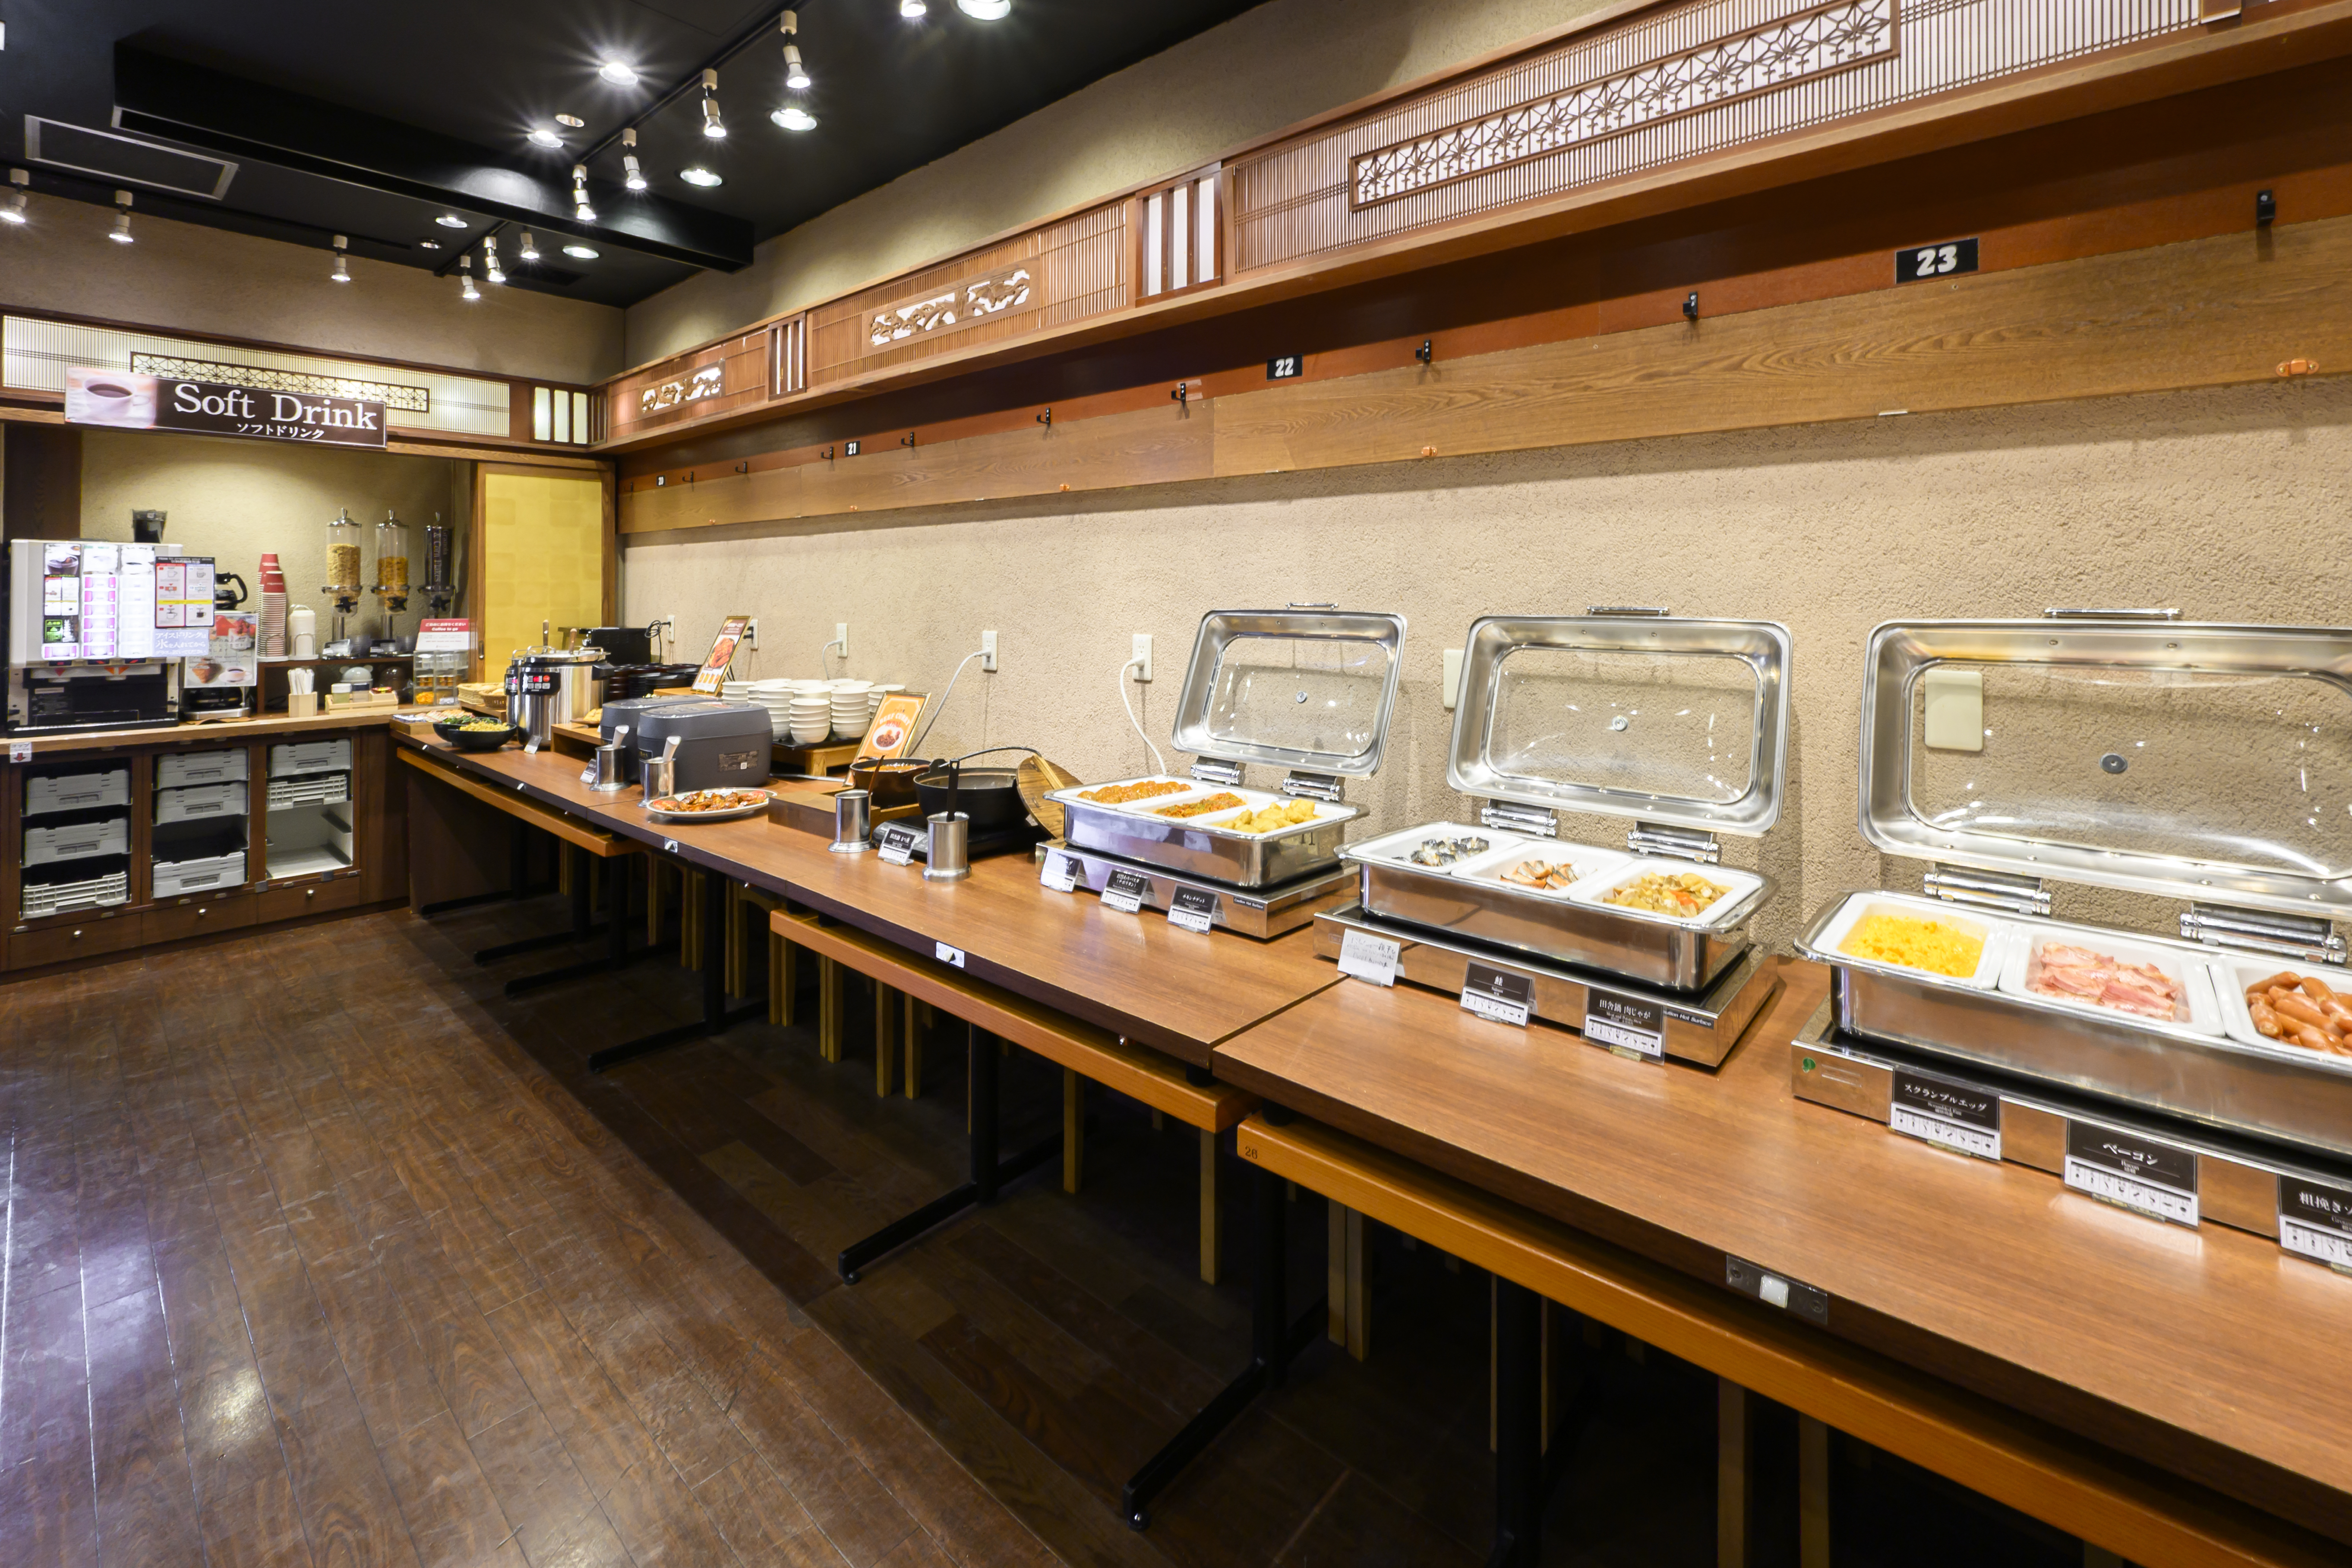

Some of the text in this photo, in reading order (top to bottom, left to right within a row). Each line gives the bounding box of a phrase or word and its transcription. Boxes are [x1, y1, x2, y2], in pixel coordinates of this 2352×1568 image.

[1916, 245, 1957, 276] 23
[1275, 357, 1294, 377] 22
[174, 383, 377, 430] Soft Drink
[237, 423, 324, 440] ソフトドリンク
[848, 442, 856, 454] 21
[879, 713, 911, 726] BEEF CURRY
[1494, 975, 1503, 987] 鮭
[1600, 999, 1651, 1019] 田舎鍋 肉じゃが
[1691, 1016, 1712, 1027] Surface
[1904, 1083, 1987, 1112] スクランブルエッグ
[1245, 1146, 1257, 1160] 26
[2103, 1143, 2158, 1165] ベーコン
